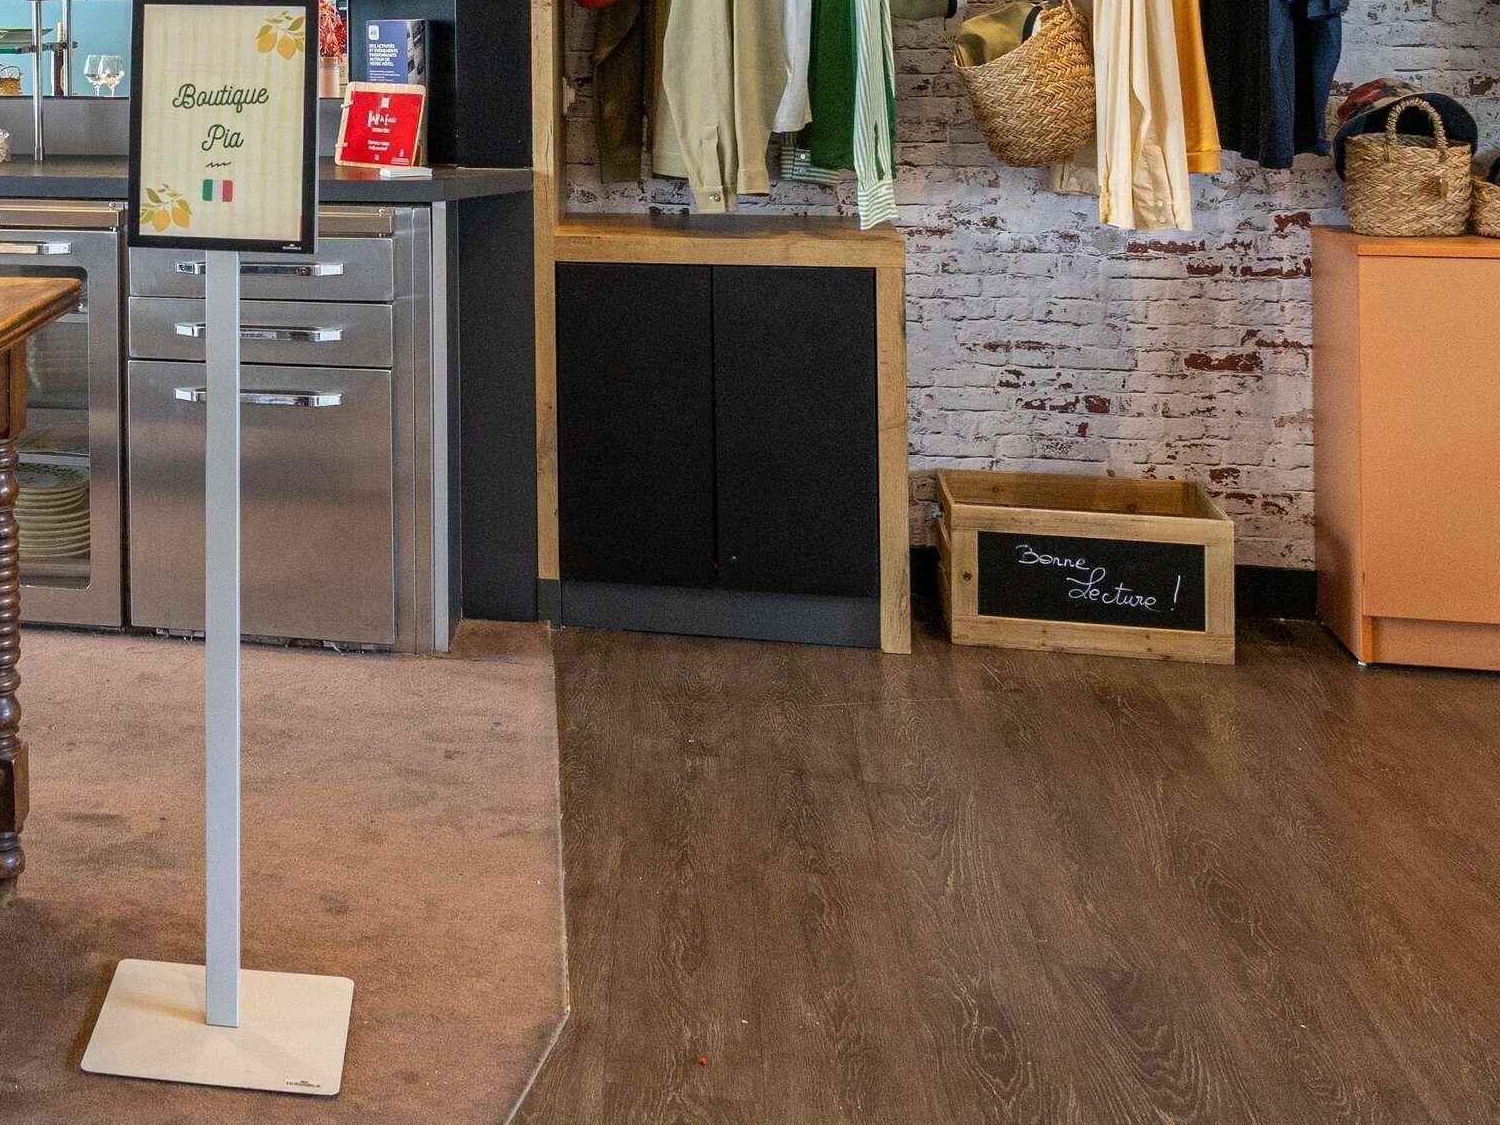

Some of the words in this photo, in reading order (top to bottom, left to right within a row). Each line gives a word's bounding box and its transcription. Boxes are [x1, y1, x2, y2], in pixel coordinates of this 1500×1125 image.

[172, 83, 269, 113] Boutique
[201, 124, 244, 151] Pia
[1015, 544, 1090, 570] Bonne
[1066, 567, 1160, 612] Lecture
[1170, 574, 1181, 612] !
